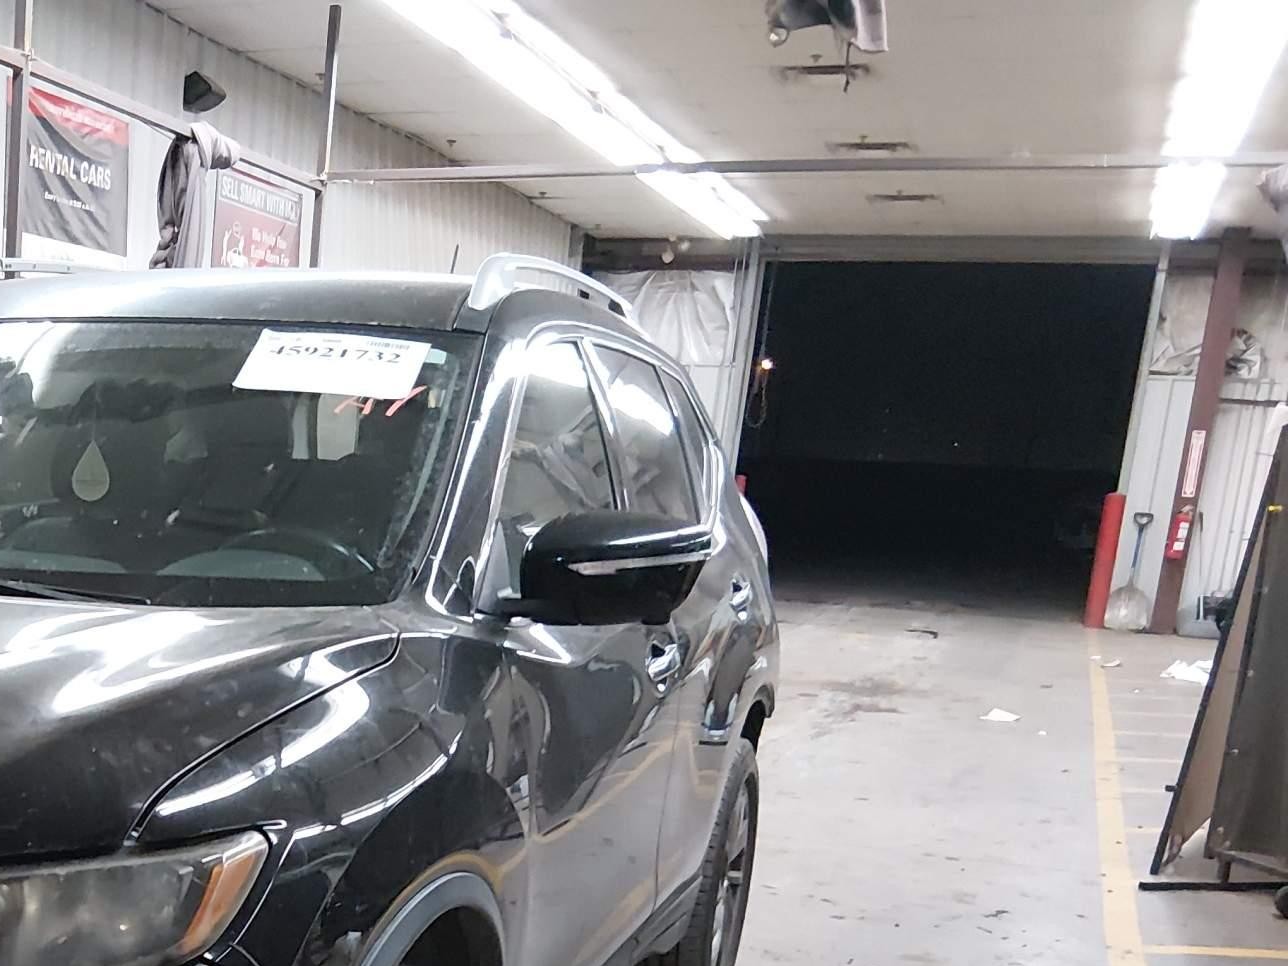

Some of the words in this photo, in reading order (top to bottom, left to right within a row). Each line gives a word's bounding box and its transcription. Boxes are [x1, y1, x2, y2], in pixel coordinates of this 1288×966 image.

[29, 144, 76, 180] RENTAL
[80, 160, 111, 190] CARS
[221, 175, 239, 200] SELL
[240, 182, 265, 210] SMART
[269, 345, 401, 363] 45921732
